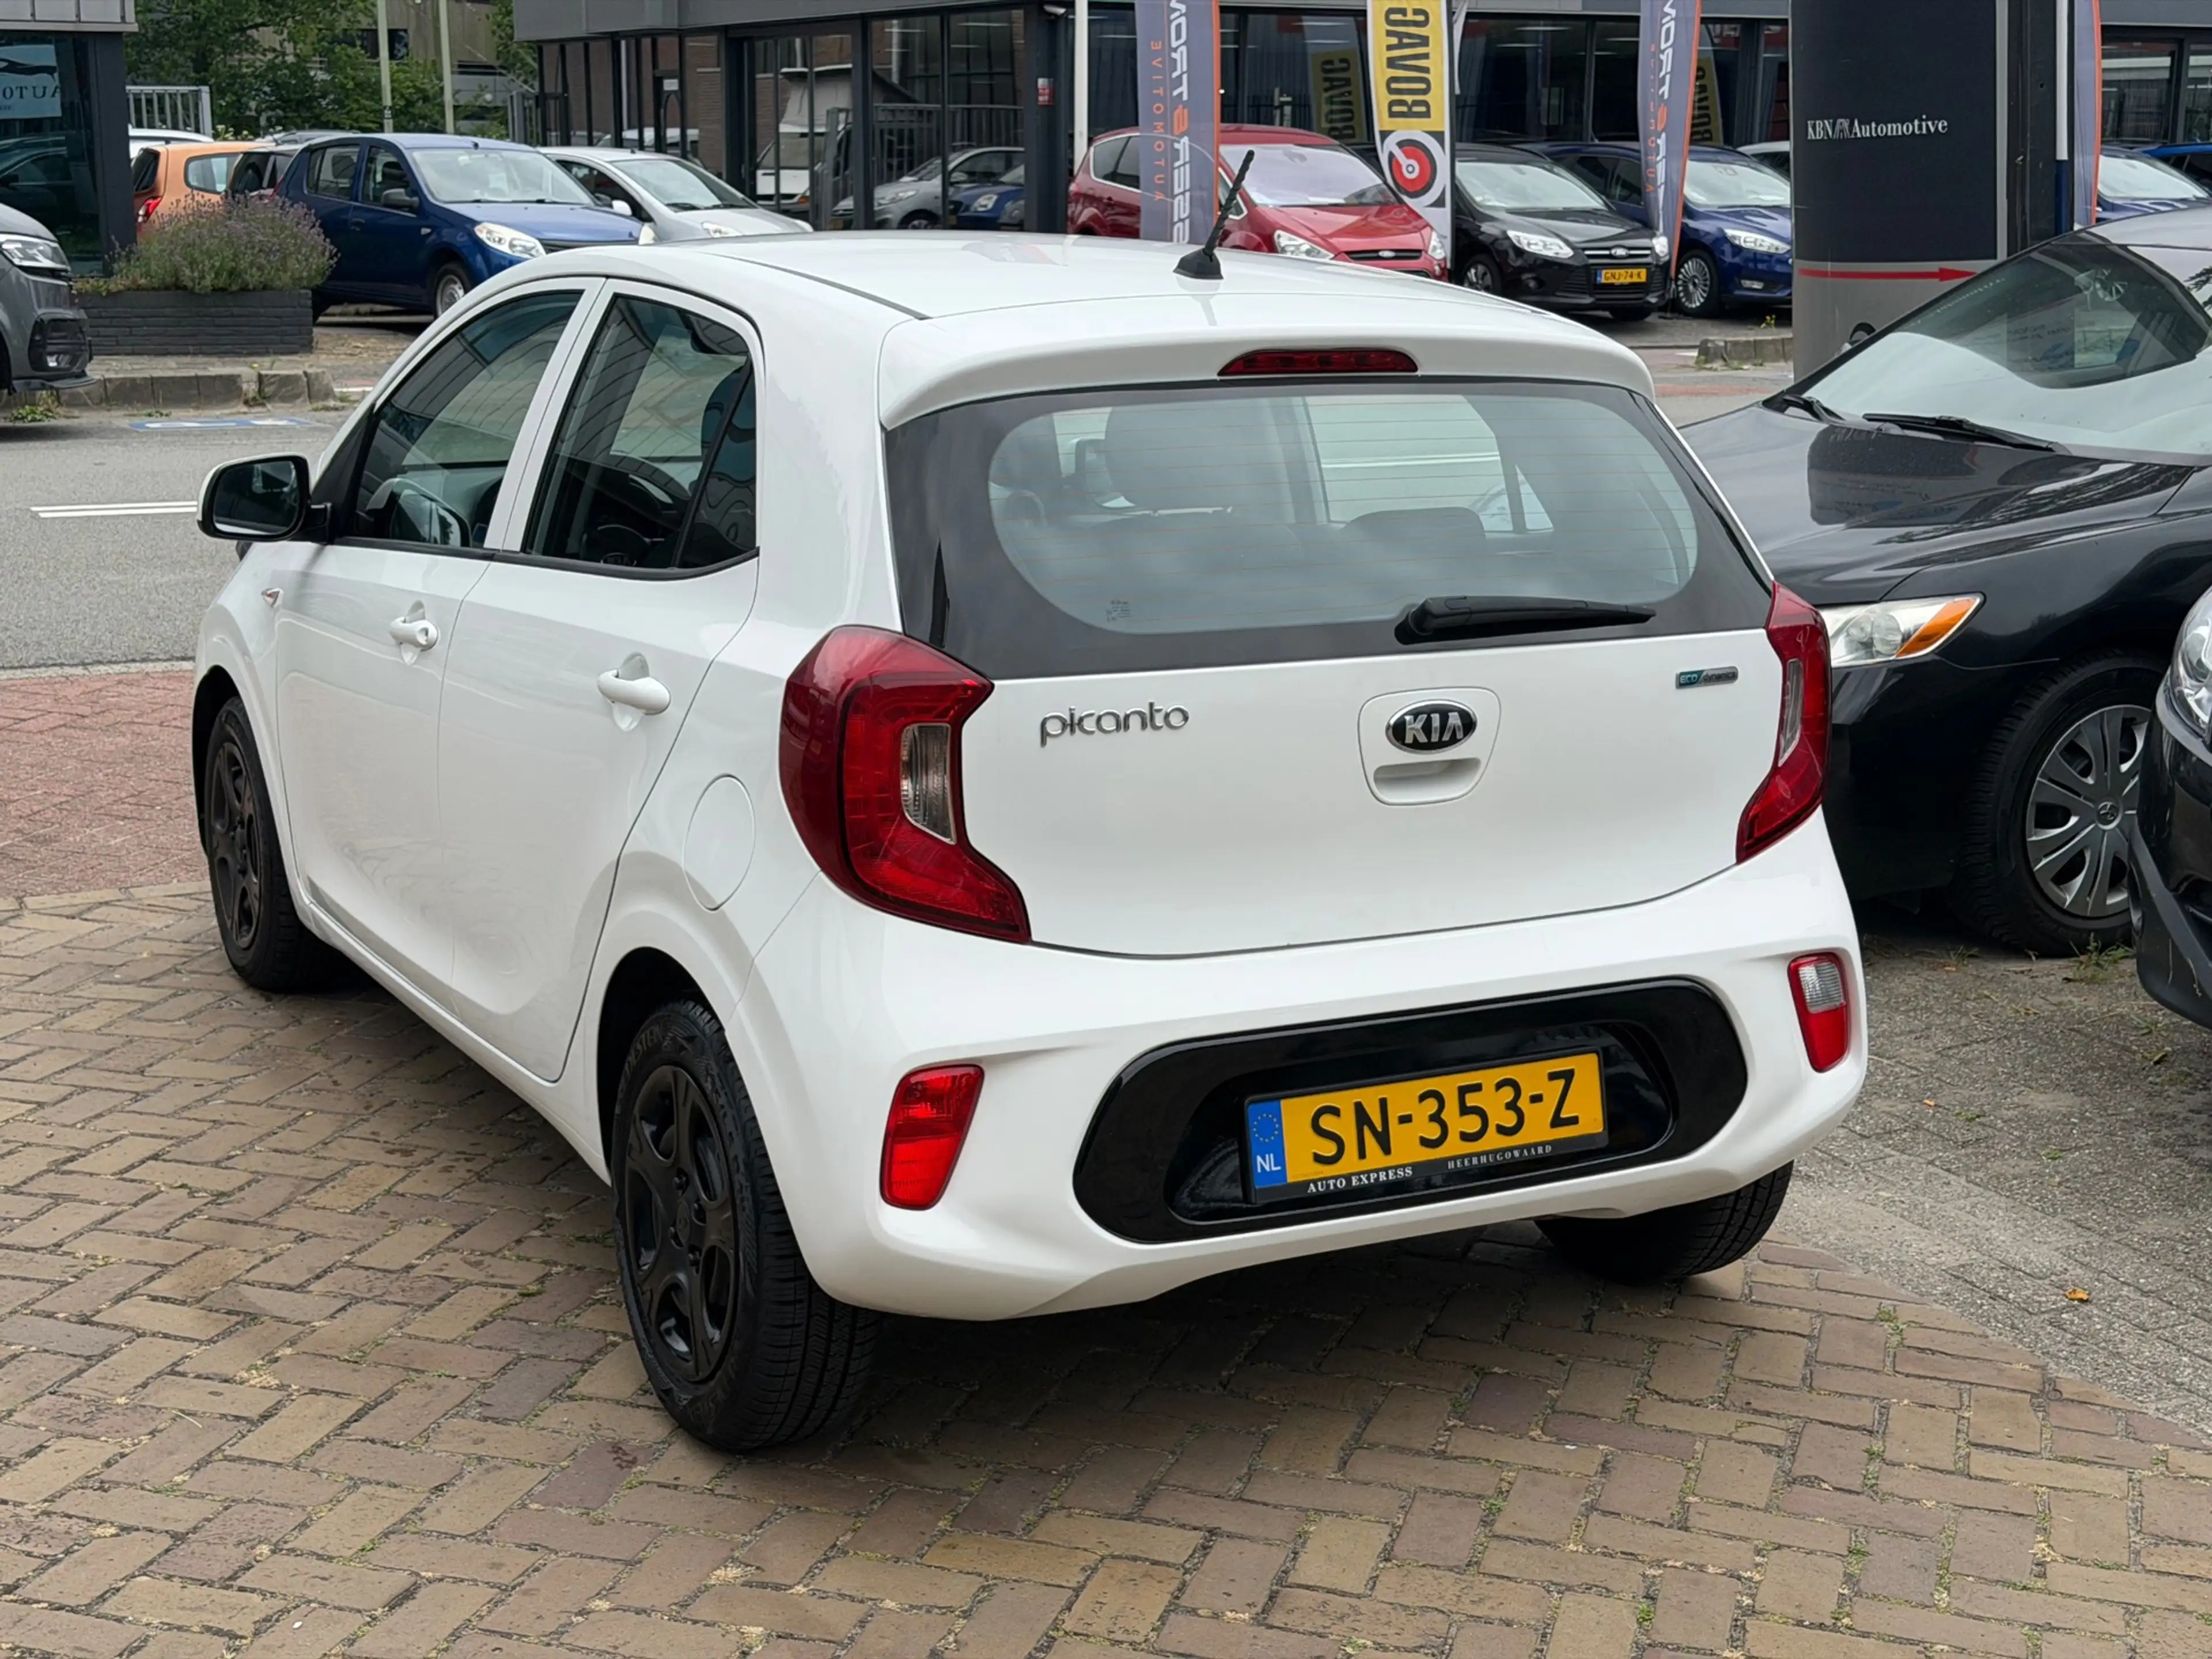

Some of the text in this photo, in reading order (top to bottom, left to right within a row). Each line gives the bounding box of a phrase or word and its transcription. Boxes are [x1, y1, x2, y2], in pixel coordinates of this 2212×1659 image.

[1807, 115, 1948, 140] KBN Automotive
[1040, 701, 1190, 748] picanto
[1404, 711, 1464, 744] KIA
[1310, 1067, 1580, 1166] SN-353-Z
[1256, 1153, 1282, 1173] NL
[1448, 1145, 1552, 1170] HEERHUGOWAARD
[1307, 1166, 1413, 1193] AUTO EXPRESS
